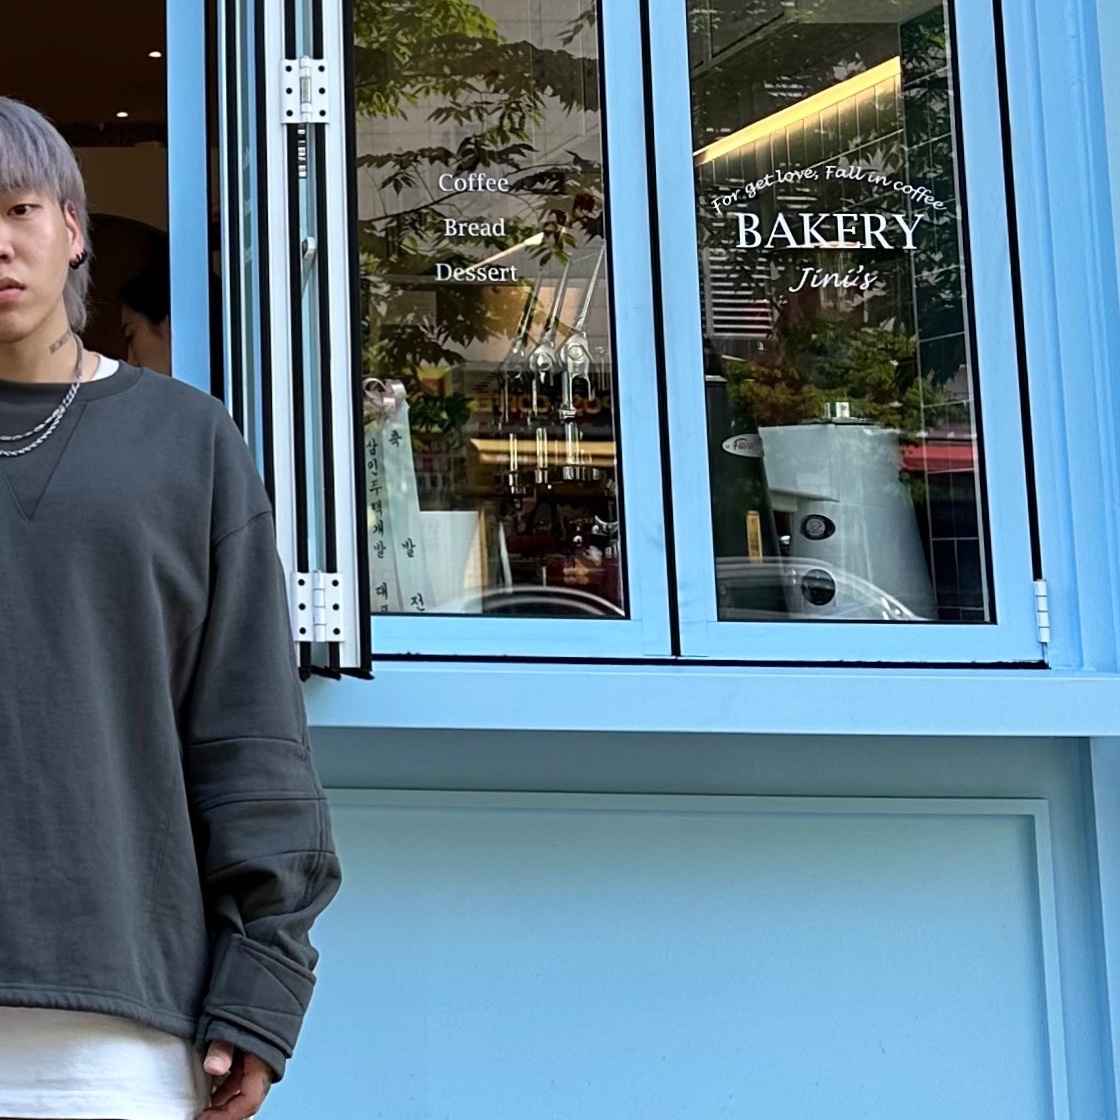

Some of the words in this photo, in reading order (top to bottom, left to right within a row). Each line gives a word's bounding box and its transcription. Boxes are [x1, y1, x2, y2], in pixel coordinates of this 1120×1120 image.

[438, 172, 509, 192] Coffee
[711, 190, 740, 215] For
[745, 174, 774, 198] get
[775, 168, 819, 183] love,
[825, 165, 866, 180] Fall
[867, 171, 893, 186] in
[893, 180, 947, 210] coffee
[444, 217, 506, 237] Bread
[735, 212, 925, 249] BAKERY
[435, 262, 518, 282] Dessert
[788, 264, 878, 292] Jini's
